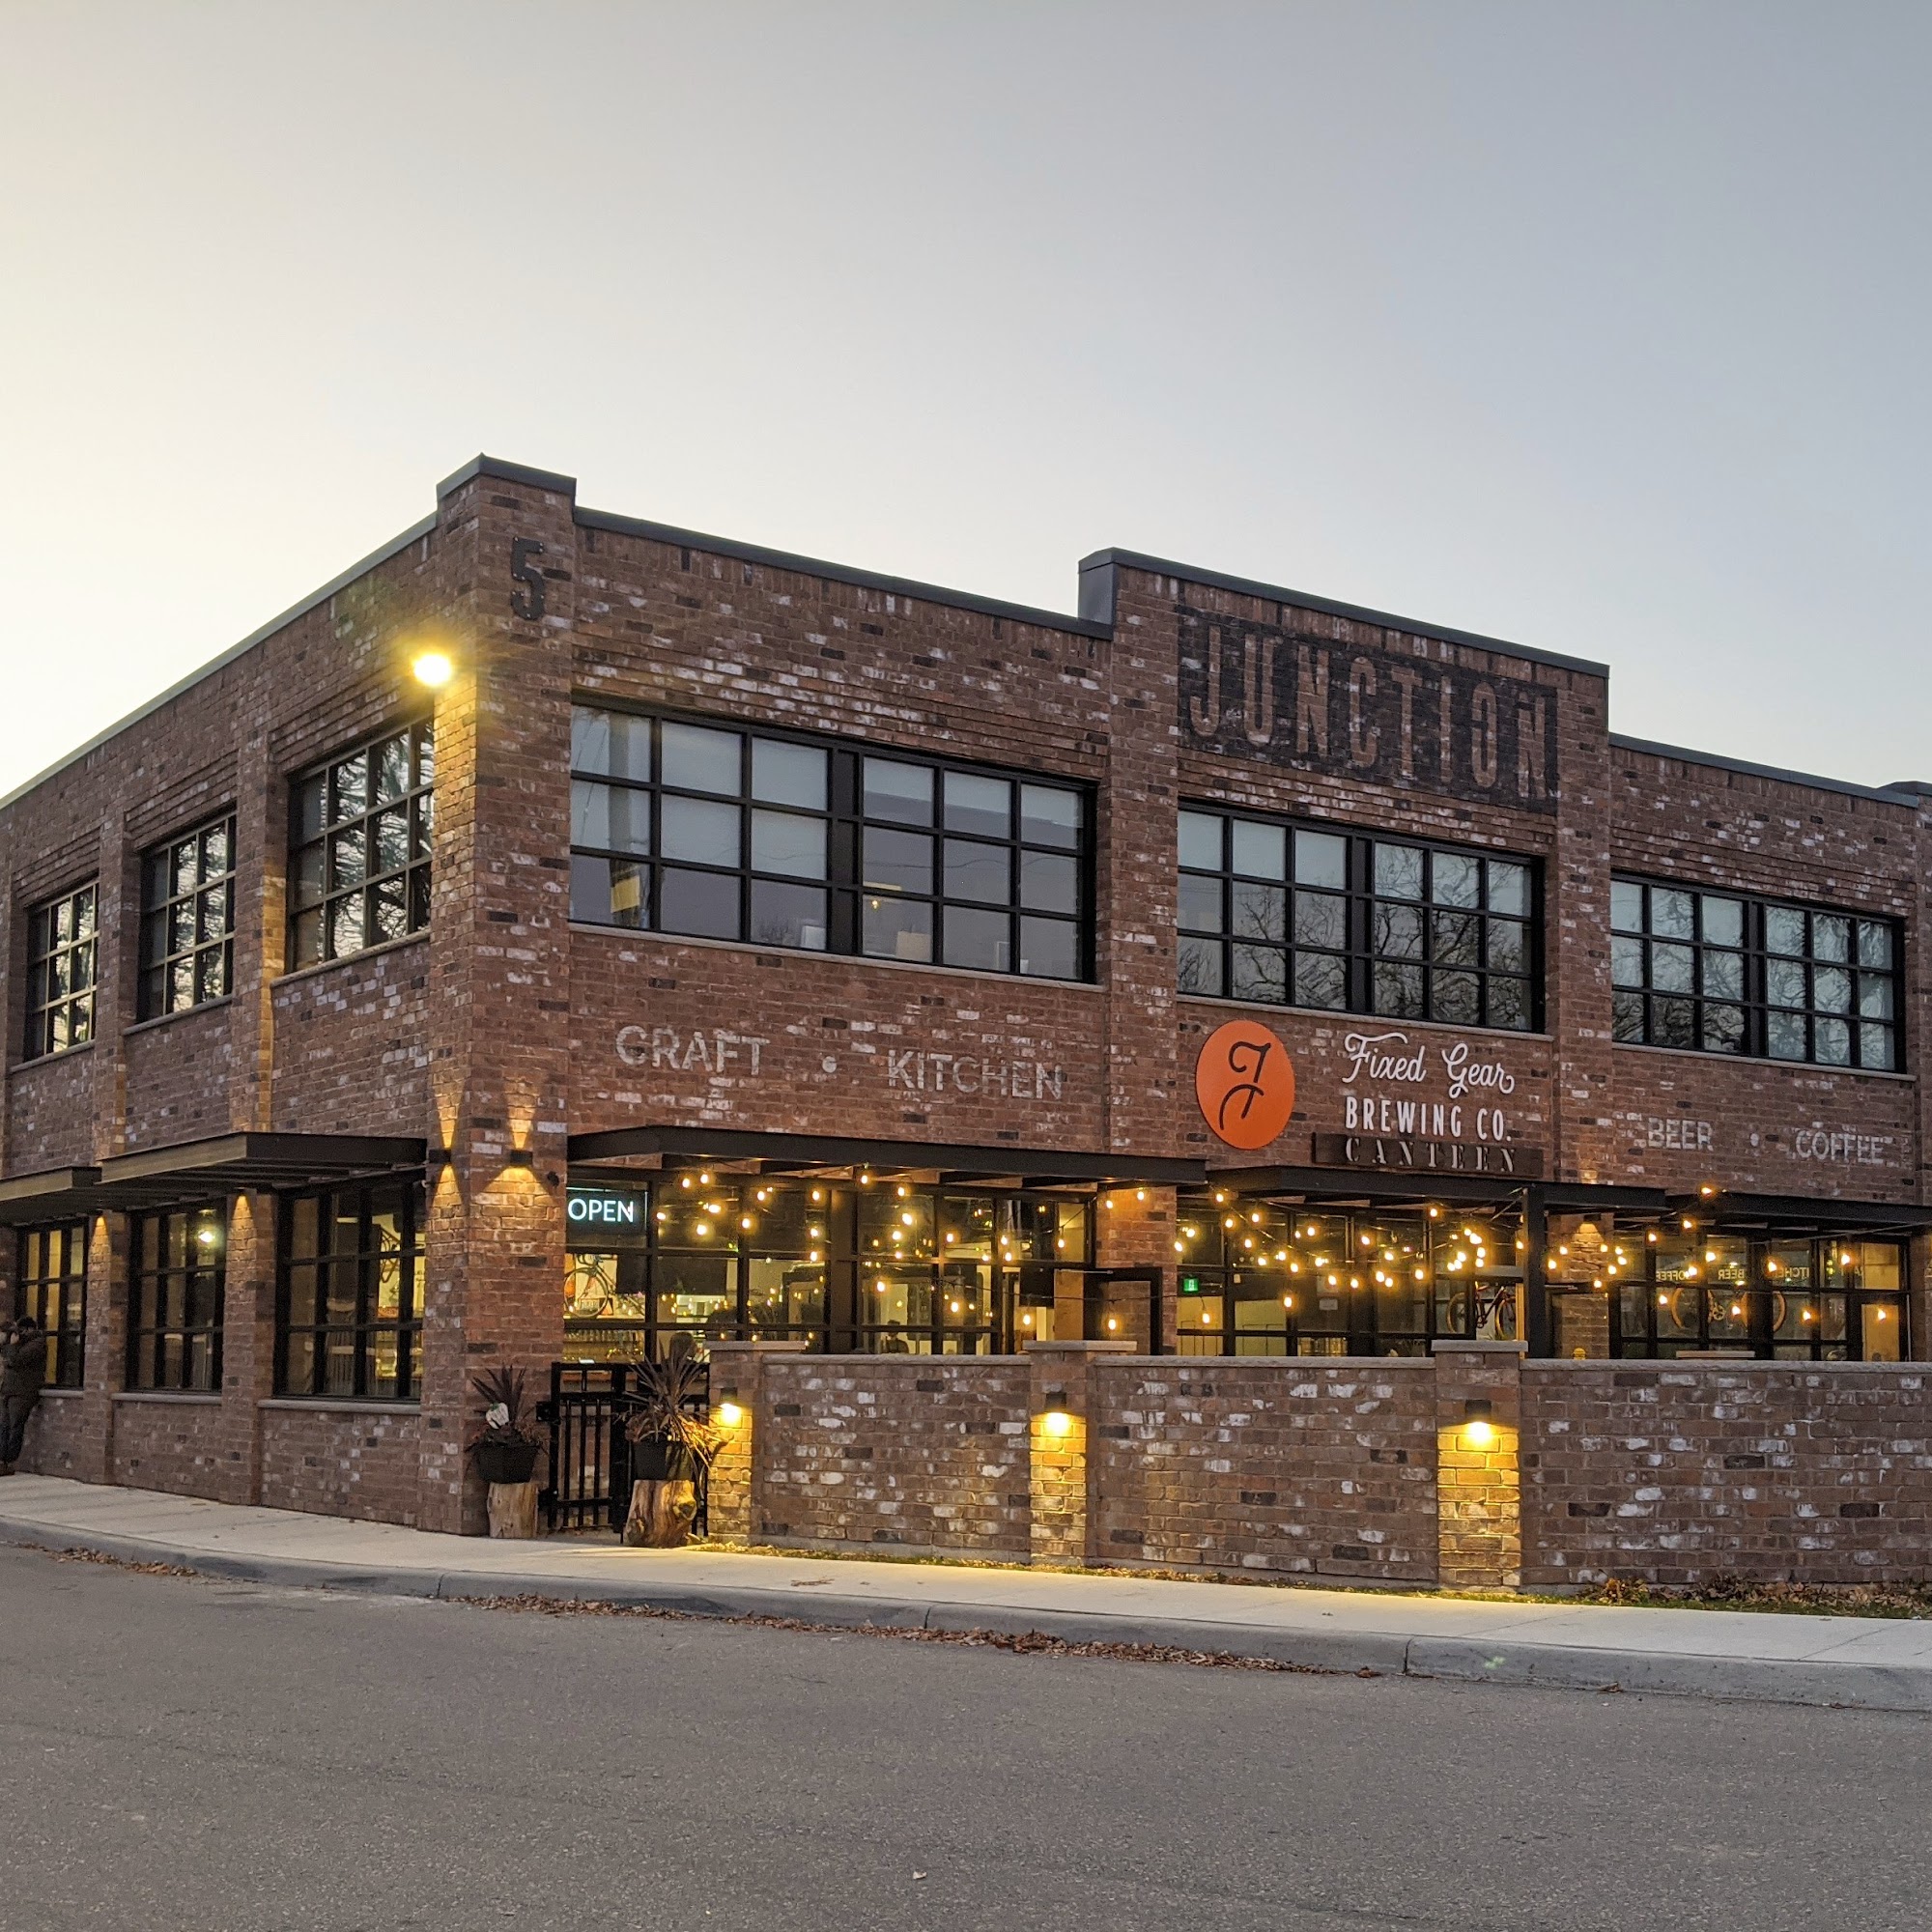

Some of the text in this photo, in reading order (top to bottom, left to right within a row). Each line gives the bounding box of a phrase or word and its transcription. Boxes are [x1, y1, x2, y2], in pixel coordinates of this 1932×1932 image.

[510, 537, 545, 621] 5
[1189, 625, 1547, 799] JUNCTION
[615, 1025, 1062, 1100] CRAFT KITCHEN
[1342, 1032, 1515, 1098] Fixed Gear
[1345, 1096, 1512, 1142] BREWING CO.
[1648, 1117, 1885, 1164] BEER COFFEE
[1346, 1138, 1516, 1173] CANTEEN
[567, 1198, 634, 1223] OPEN
